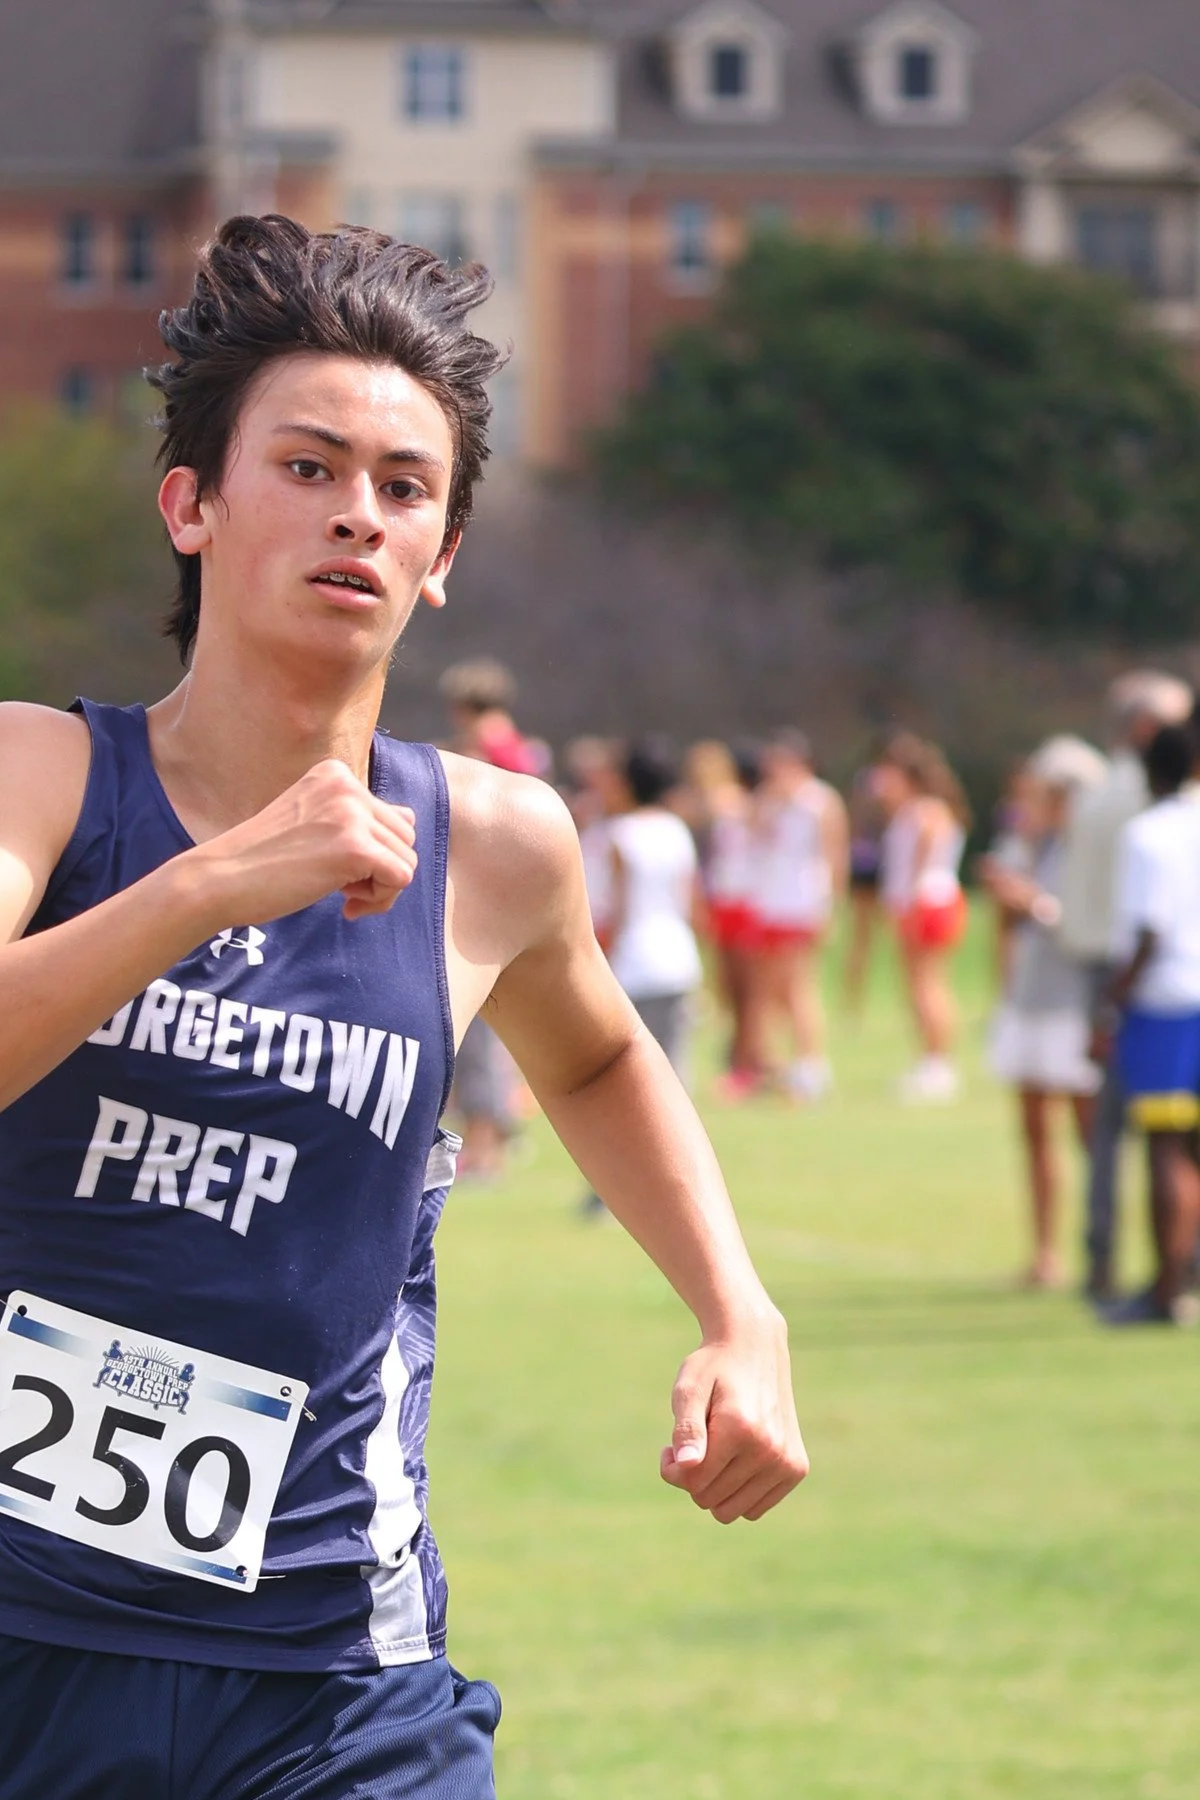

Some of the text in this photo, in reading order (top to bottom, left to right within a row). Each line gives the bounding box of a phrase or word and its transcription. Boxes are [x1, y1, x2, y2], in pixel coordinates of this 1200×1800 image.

[85, 978, 420, 1151] RGETOWN
[74, 1095, 298, 1237] PREP
[105, 1369, 180, 1405] CLASSIC
[106, 1358, 189, 1391] GEORGETOWN PREP
[146, 1360, 179, 1379] ANNUAL
